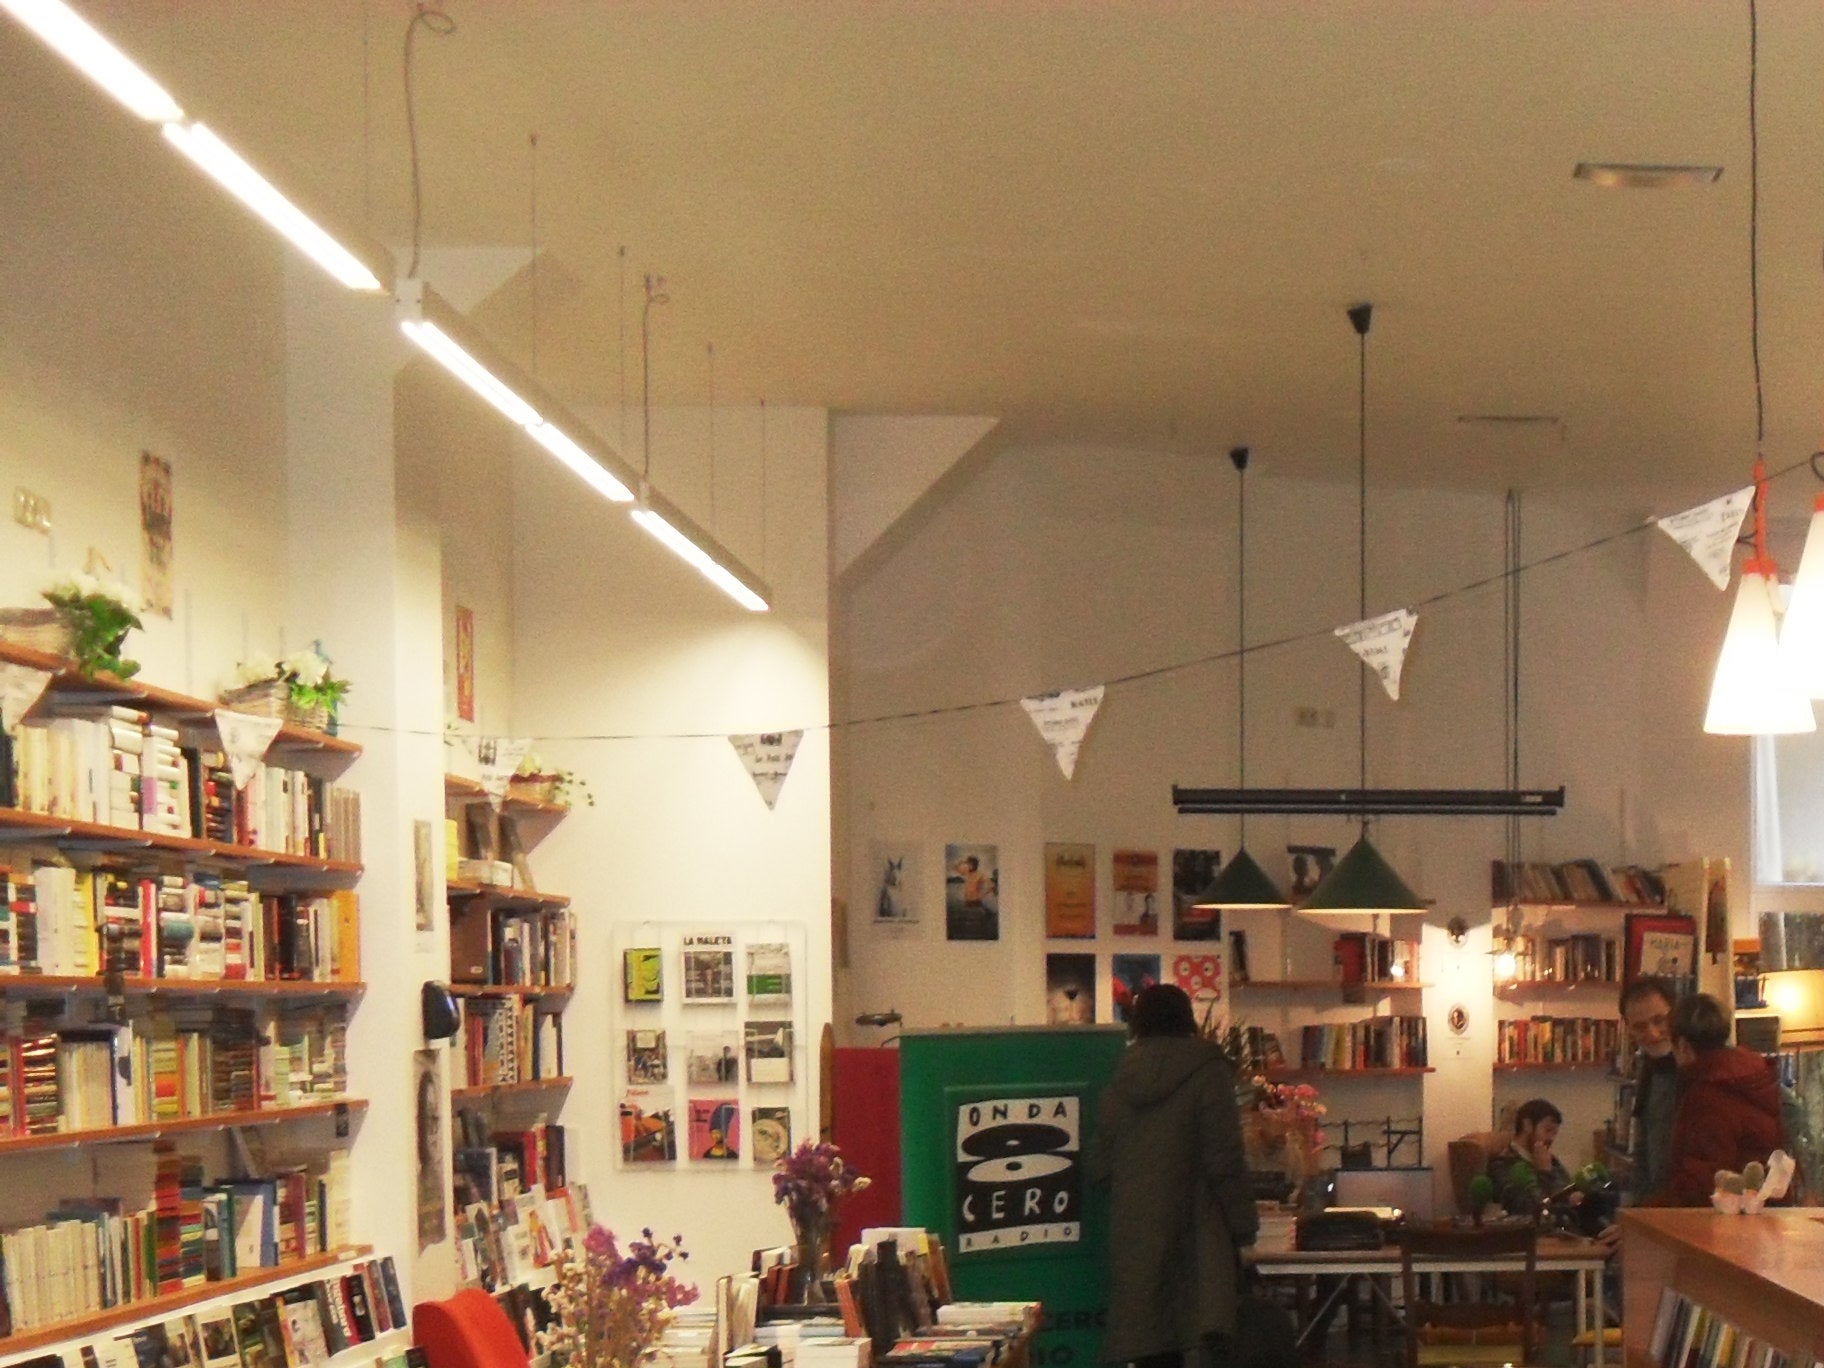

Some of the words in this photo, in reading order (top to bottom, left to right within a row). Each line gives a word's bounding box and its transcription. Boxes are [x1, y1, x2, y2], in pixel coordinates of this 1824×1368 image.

[968, 1101, 1068, 1127] ONDA
[962, 1187, 1069, 1222] CERO
[965, 1226, 1073, 1248] RADIO
